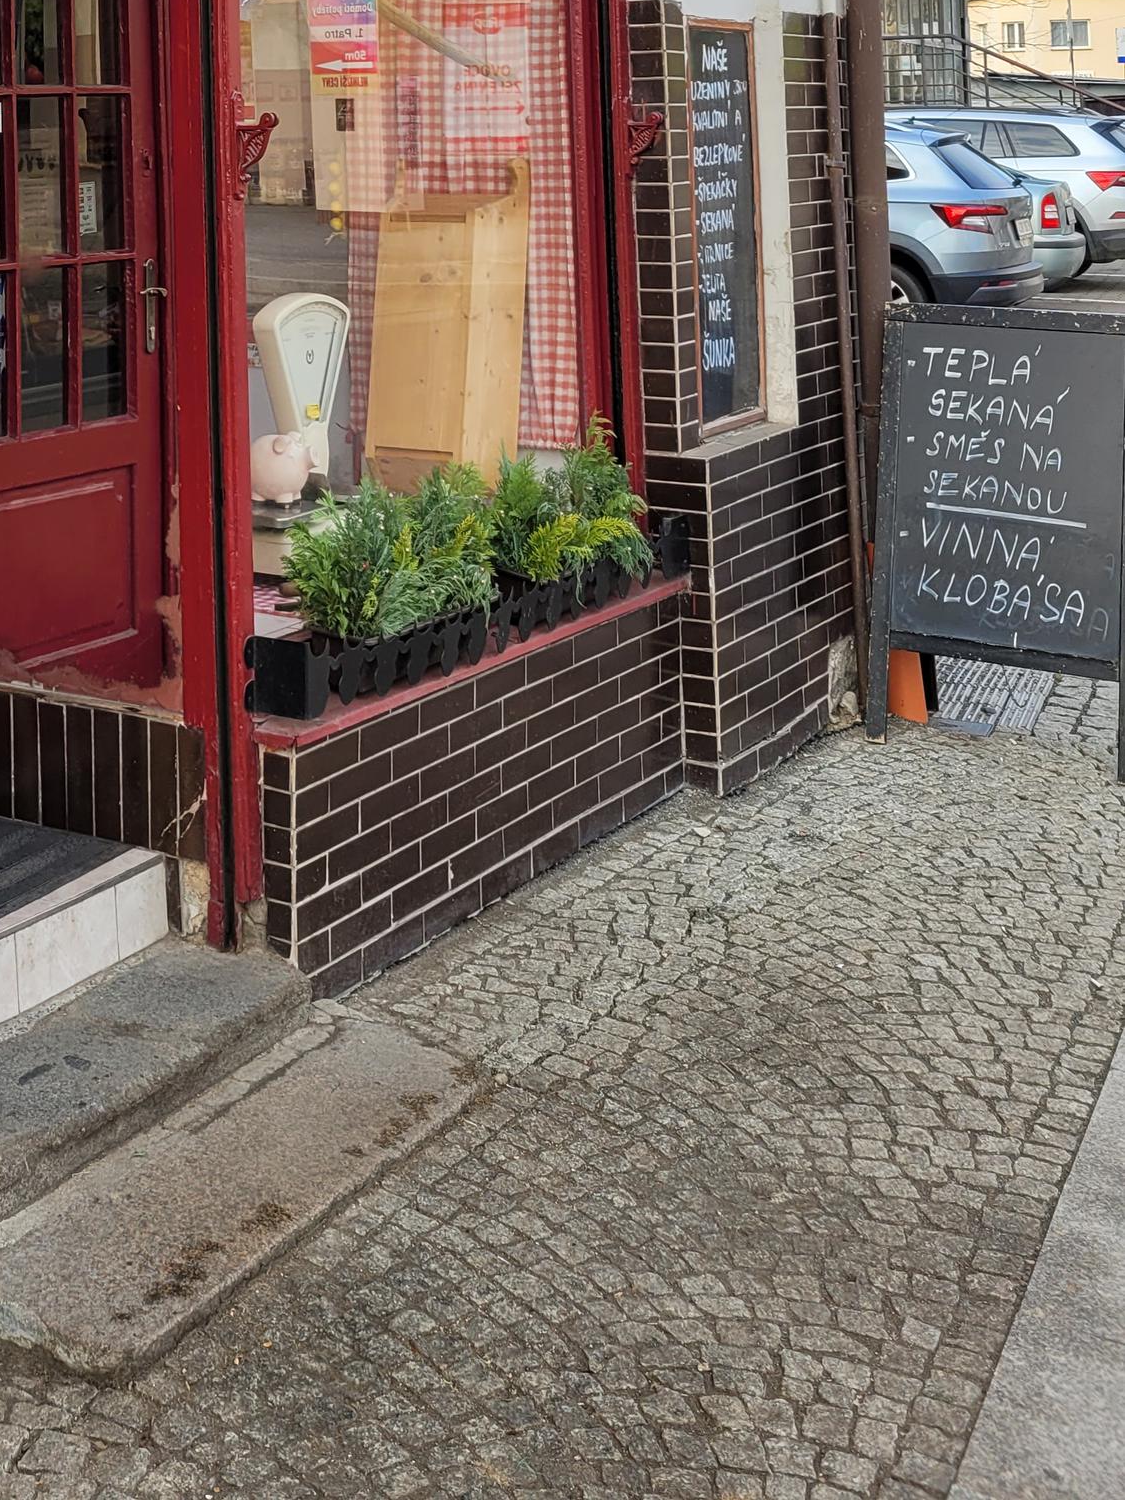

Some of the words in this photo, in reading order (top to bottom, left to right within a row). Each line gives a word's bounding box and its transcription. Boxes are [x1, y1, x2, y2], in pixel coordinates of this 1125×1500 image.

[702, 40, 728, 73] NAŠE
[690, 79, 731, 101] UZENINY
[734, 109, 742, 126] A
[693, 133, 746, 167] BEZLEPKOVÉ
[708, 293, 732, 322] NAŠE
[703, 333, 736, 371] ŠUNKA
[922, 344, 1042, 386] TEPLÁ
[928, 386, 1071, 436] SEKANÁ
[925, 429, 1005, 465] SMĚS
[1019, 442, 1062, 473] NA
[923, 469, 1068, 515] SEKANOU
[921, 516, 1056, 572] VINNÁ
[917, 562, 1086, 628] KLOBÁSA
